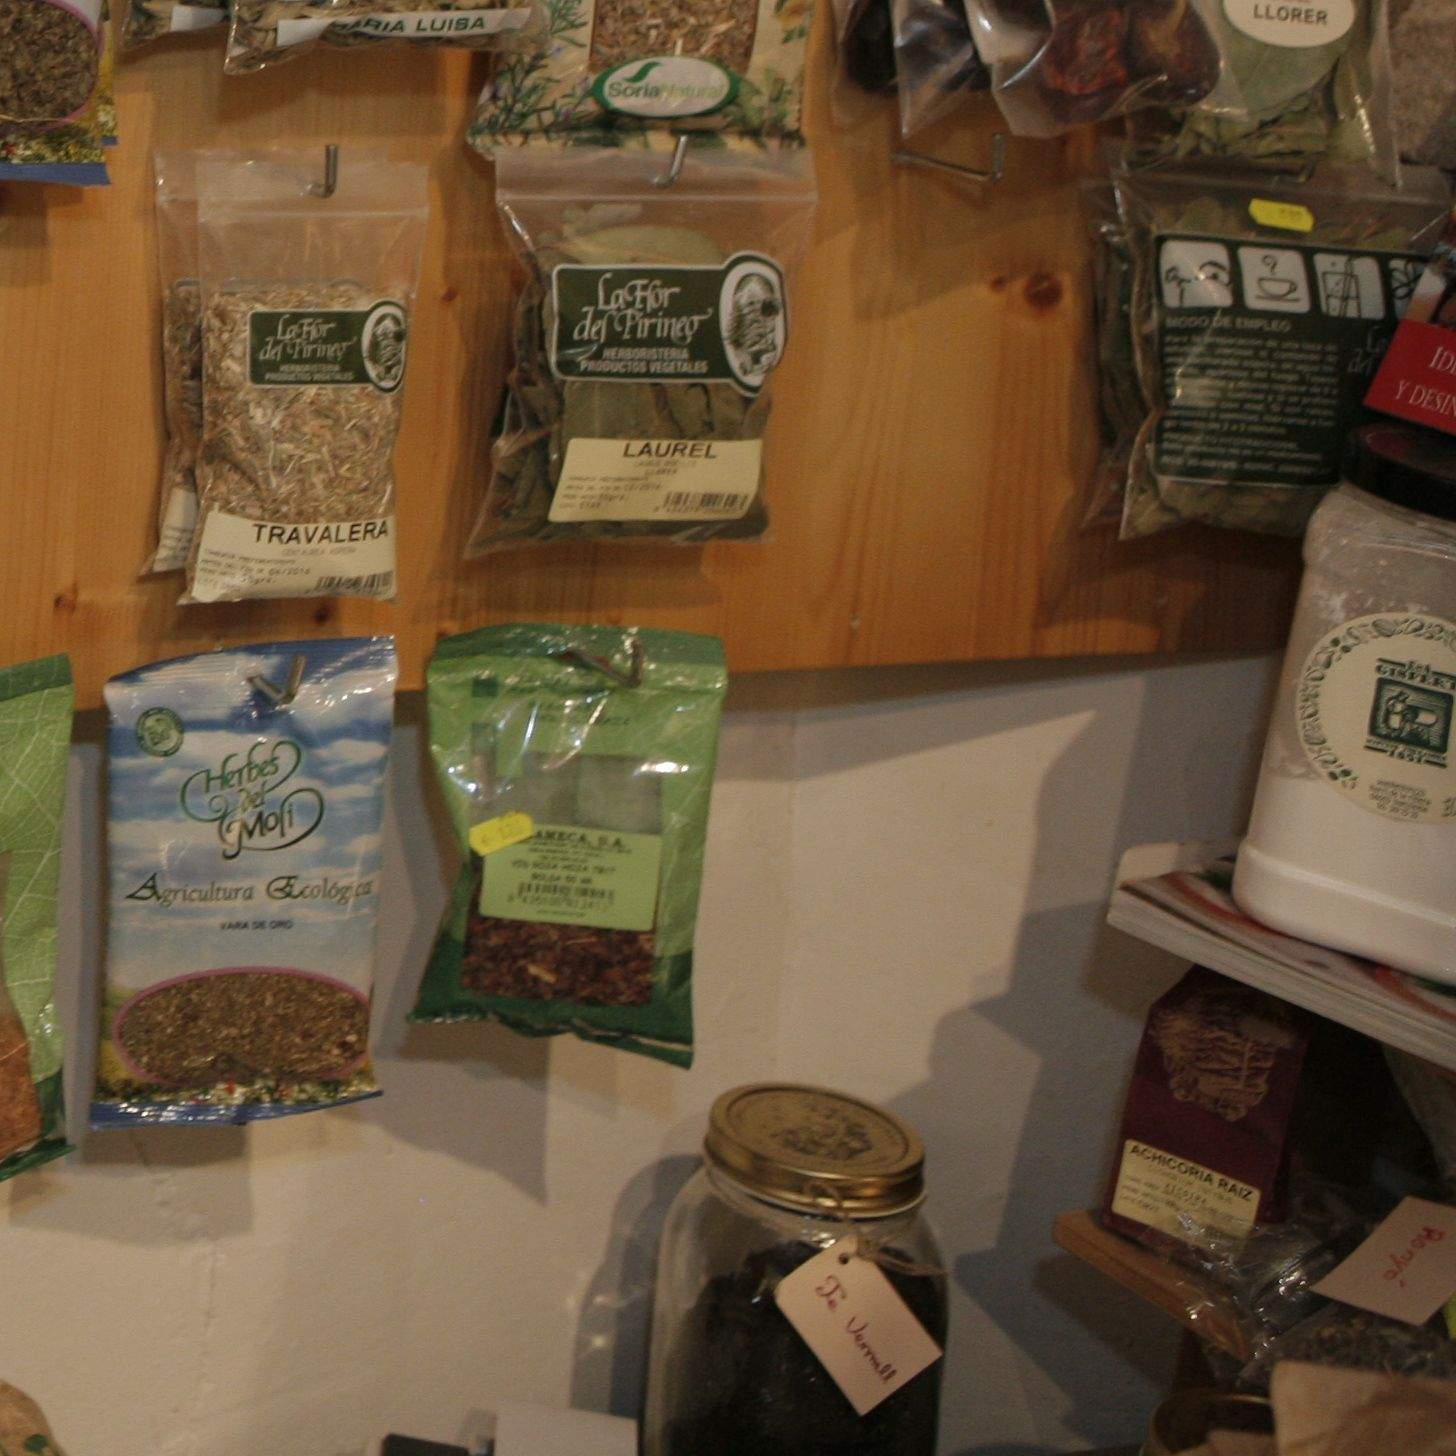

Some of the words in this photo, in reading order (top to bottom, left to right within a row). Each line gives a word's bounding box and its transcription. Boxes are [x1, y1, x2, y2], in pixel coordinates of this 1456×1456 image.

[415, 17, 486, 34] LUISA
[1253, 3, 1329, 26] LLORER
[597, 273, 623, 311] La
[621, 280, 681, 310] Flor
[573, 307, 612, 342] del
[650, 361, 709, 375] VEGETALES
[623, 443, 717, 459] LAUREL
[254, 522, 388, 545] TRAVALERA
[191, 741, 293, 806] Herbes
[125, 873, 254, 908] Agricultura
[1130, 1145, 1213, 1185] ACHICORIA
[1218, 1177, 1254, 1202] RAIZ
